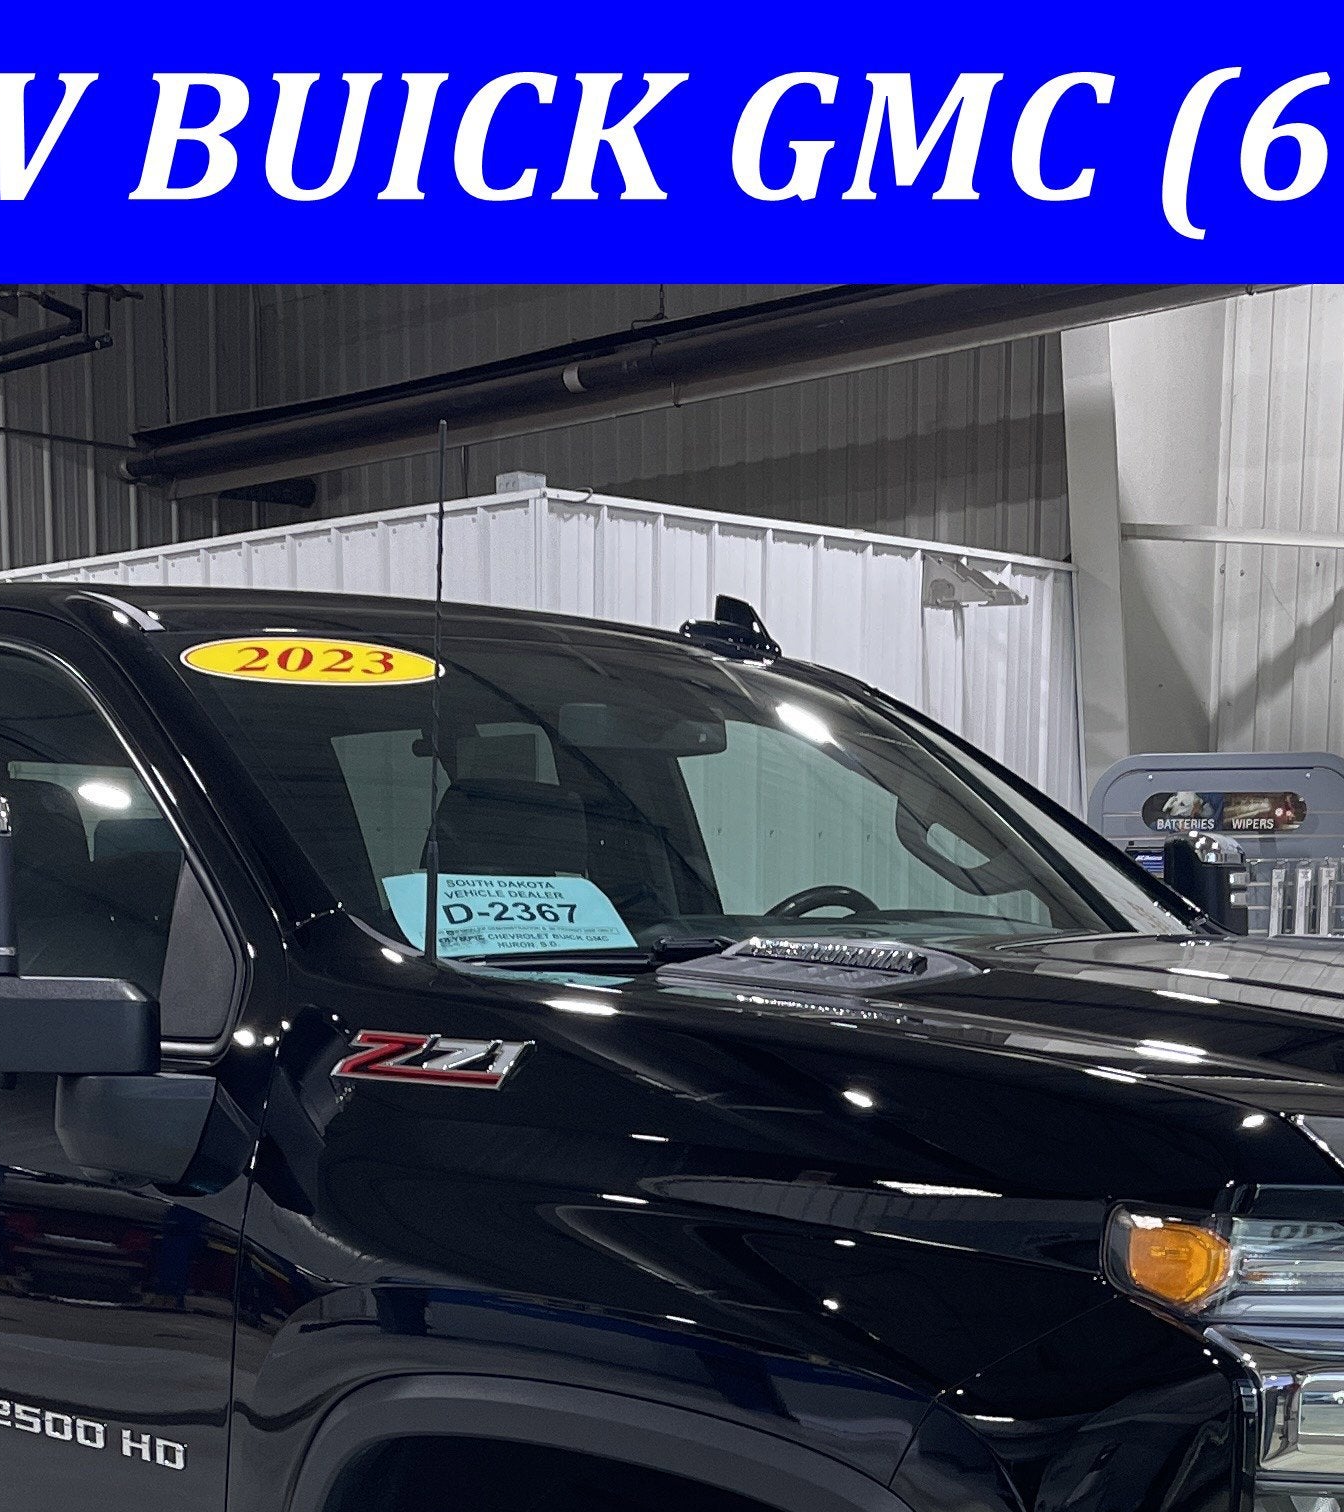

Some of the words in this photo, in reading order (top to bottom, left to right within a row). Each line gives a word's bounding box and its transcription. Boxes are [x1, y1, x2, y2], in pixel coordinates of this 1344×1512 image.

[234, 646, 394, 675] 2023
[1156, 818, 1215, 830] BATTERIES
[1231, 818, 1274, 830] WIPERS
[444, 890, 504, 899] VEHICLE
[508, 891, 565, 900] DEALER
[446, 880, 494, 888] SOUTH
[498, 880, 555, 889] DAKOTA
[442, 902, 577, 925] D-2367
[330, 1029, 536, 1090] Z71
[121, 1428, 187, 1470] HD
